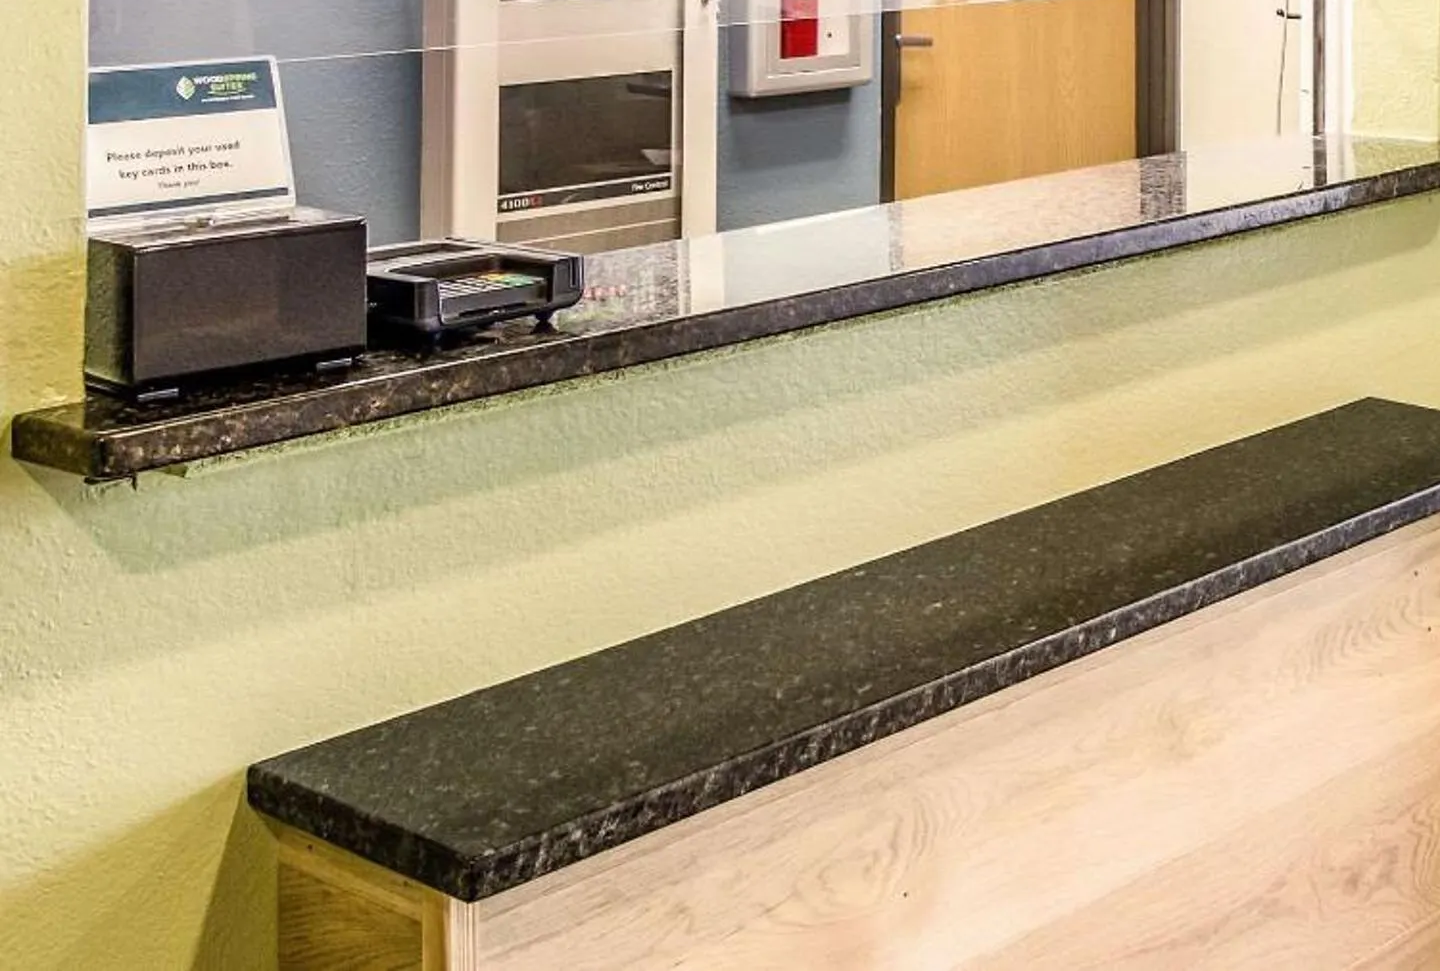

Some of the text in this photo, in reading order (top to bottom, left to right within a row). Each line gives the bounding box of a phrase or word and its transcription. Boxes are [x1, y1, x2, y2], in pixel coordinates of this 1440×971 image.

[107, 139, 241, 162] Please deposit your used
[118, 159, 233, 180] key cards in this box.
